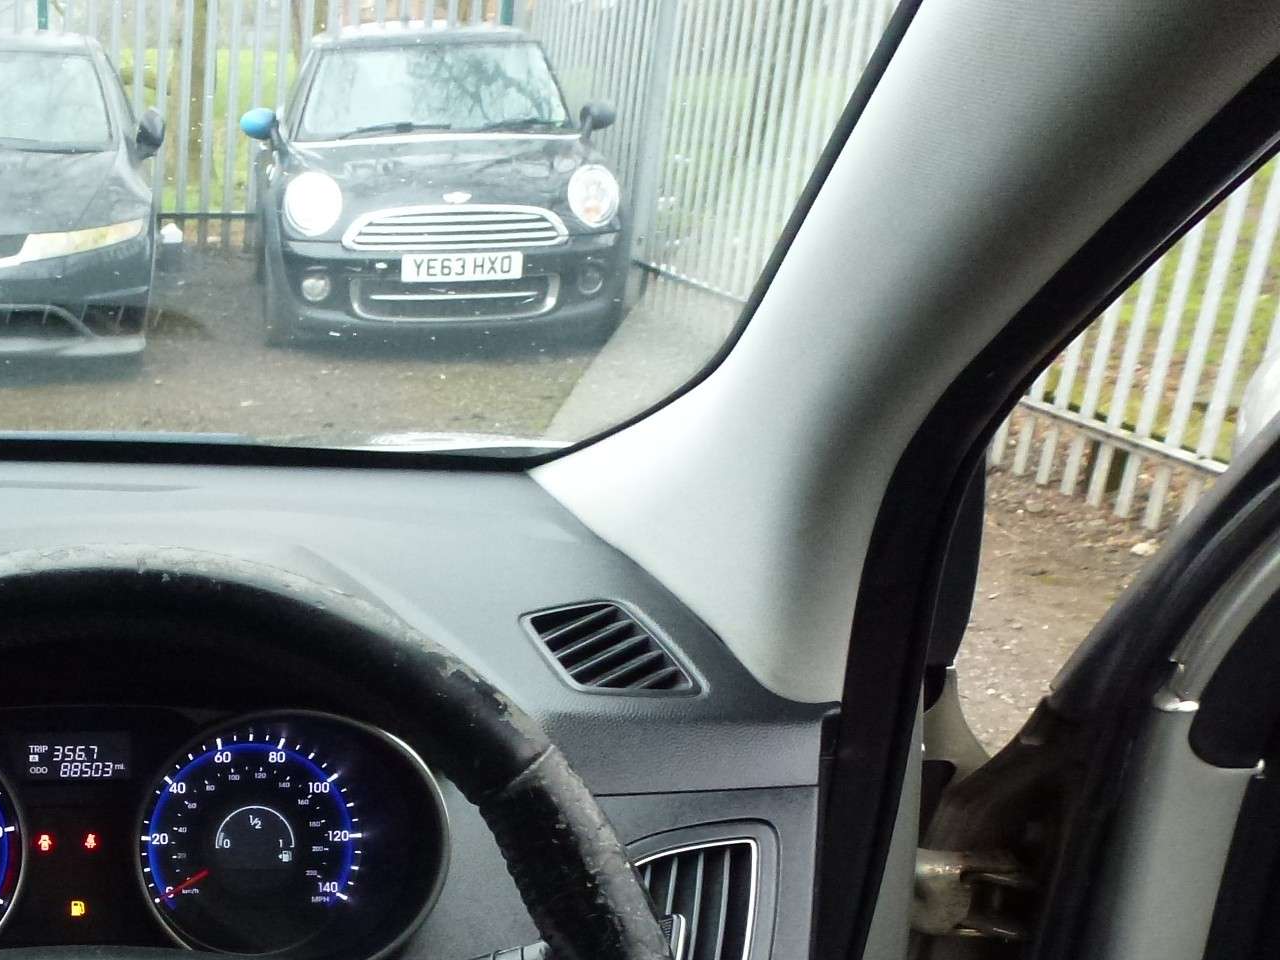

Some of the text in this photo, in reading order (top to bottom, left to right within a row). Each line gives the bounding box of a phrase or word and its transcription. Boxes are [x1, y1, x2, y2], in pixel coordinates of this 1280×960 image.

[413, 255, 513, 277] YE63 HXO
[28, 745, 48, 753] TRIP
[215, 752, 231, 763] 60
[269, 752, 285, 763] 80
[29, 766, 48, 774] ODO
[60, 763, 113, 777] 88503
[169, 783, 186, 794] 40
[308, 782, 329, 793] 100
[152, 833, 168, 844] 20
[328, 831, 349, 841] 120
[223, 839, 231, 848] 0
[278, 839, 283, 848] 1
[319, 882, 338, 893] 140
